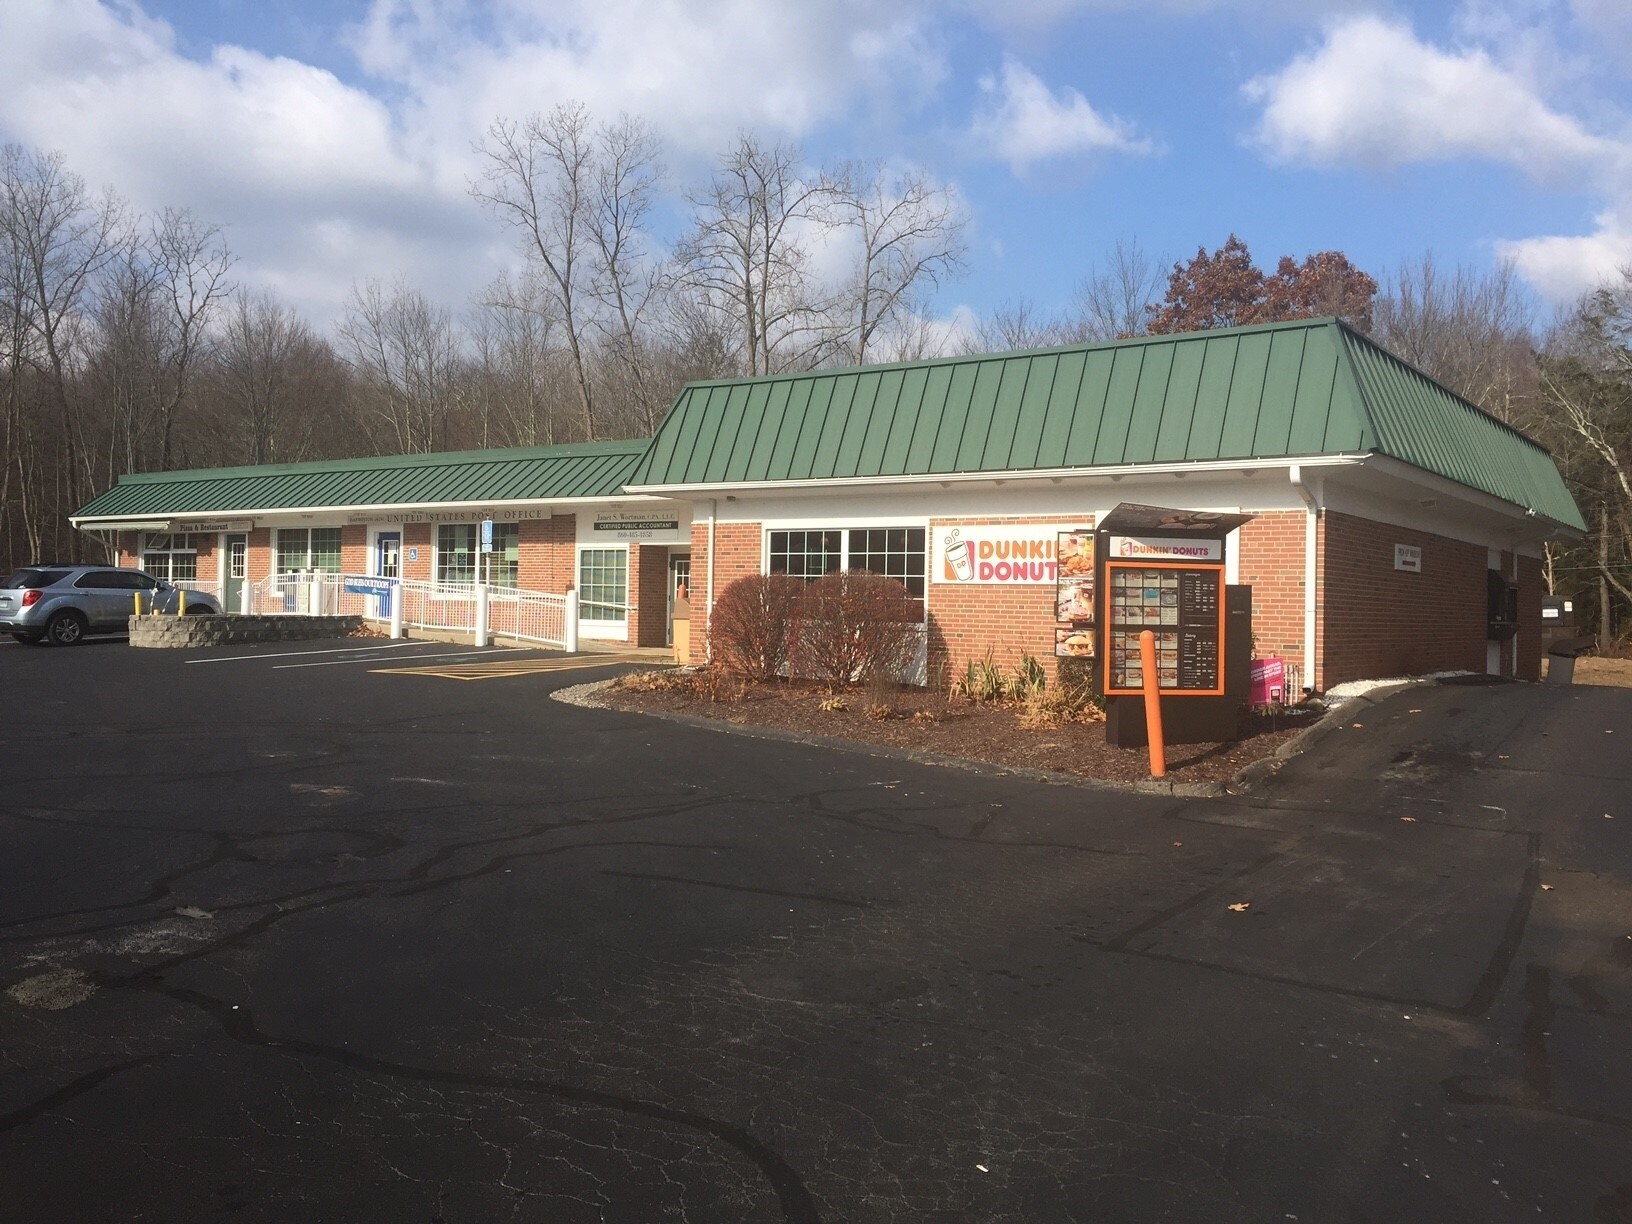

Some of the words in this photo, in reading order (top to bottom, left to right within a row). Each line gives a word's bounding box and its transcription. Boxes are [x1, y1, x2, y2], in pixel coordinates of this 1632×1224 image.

[386, 514, 422, 523] UNITED
[429, 512, 465, 521] STATES
[471, 511, 497, 520] POST
[504, 509, 542, 519] OFFICE
[596, 513, 612, 521] Janet
[200, 523, 228, 531] Restaurant
[978, 540, 1058, 560] DUNKI
[1172, 546, 1209, 556] DONUTS
[979, 561, 1058, 581] DONUT
